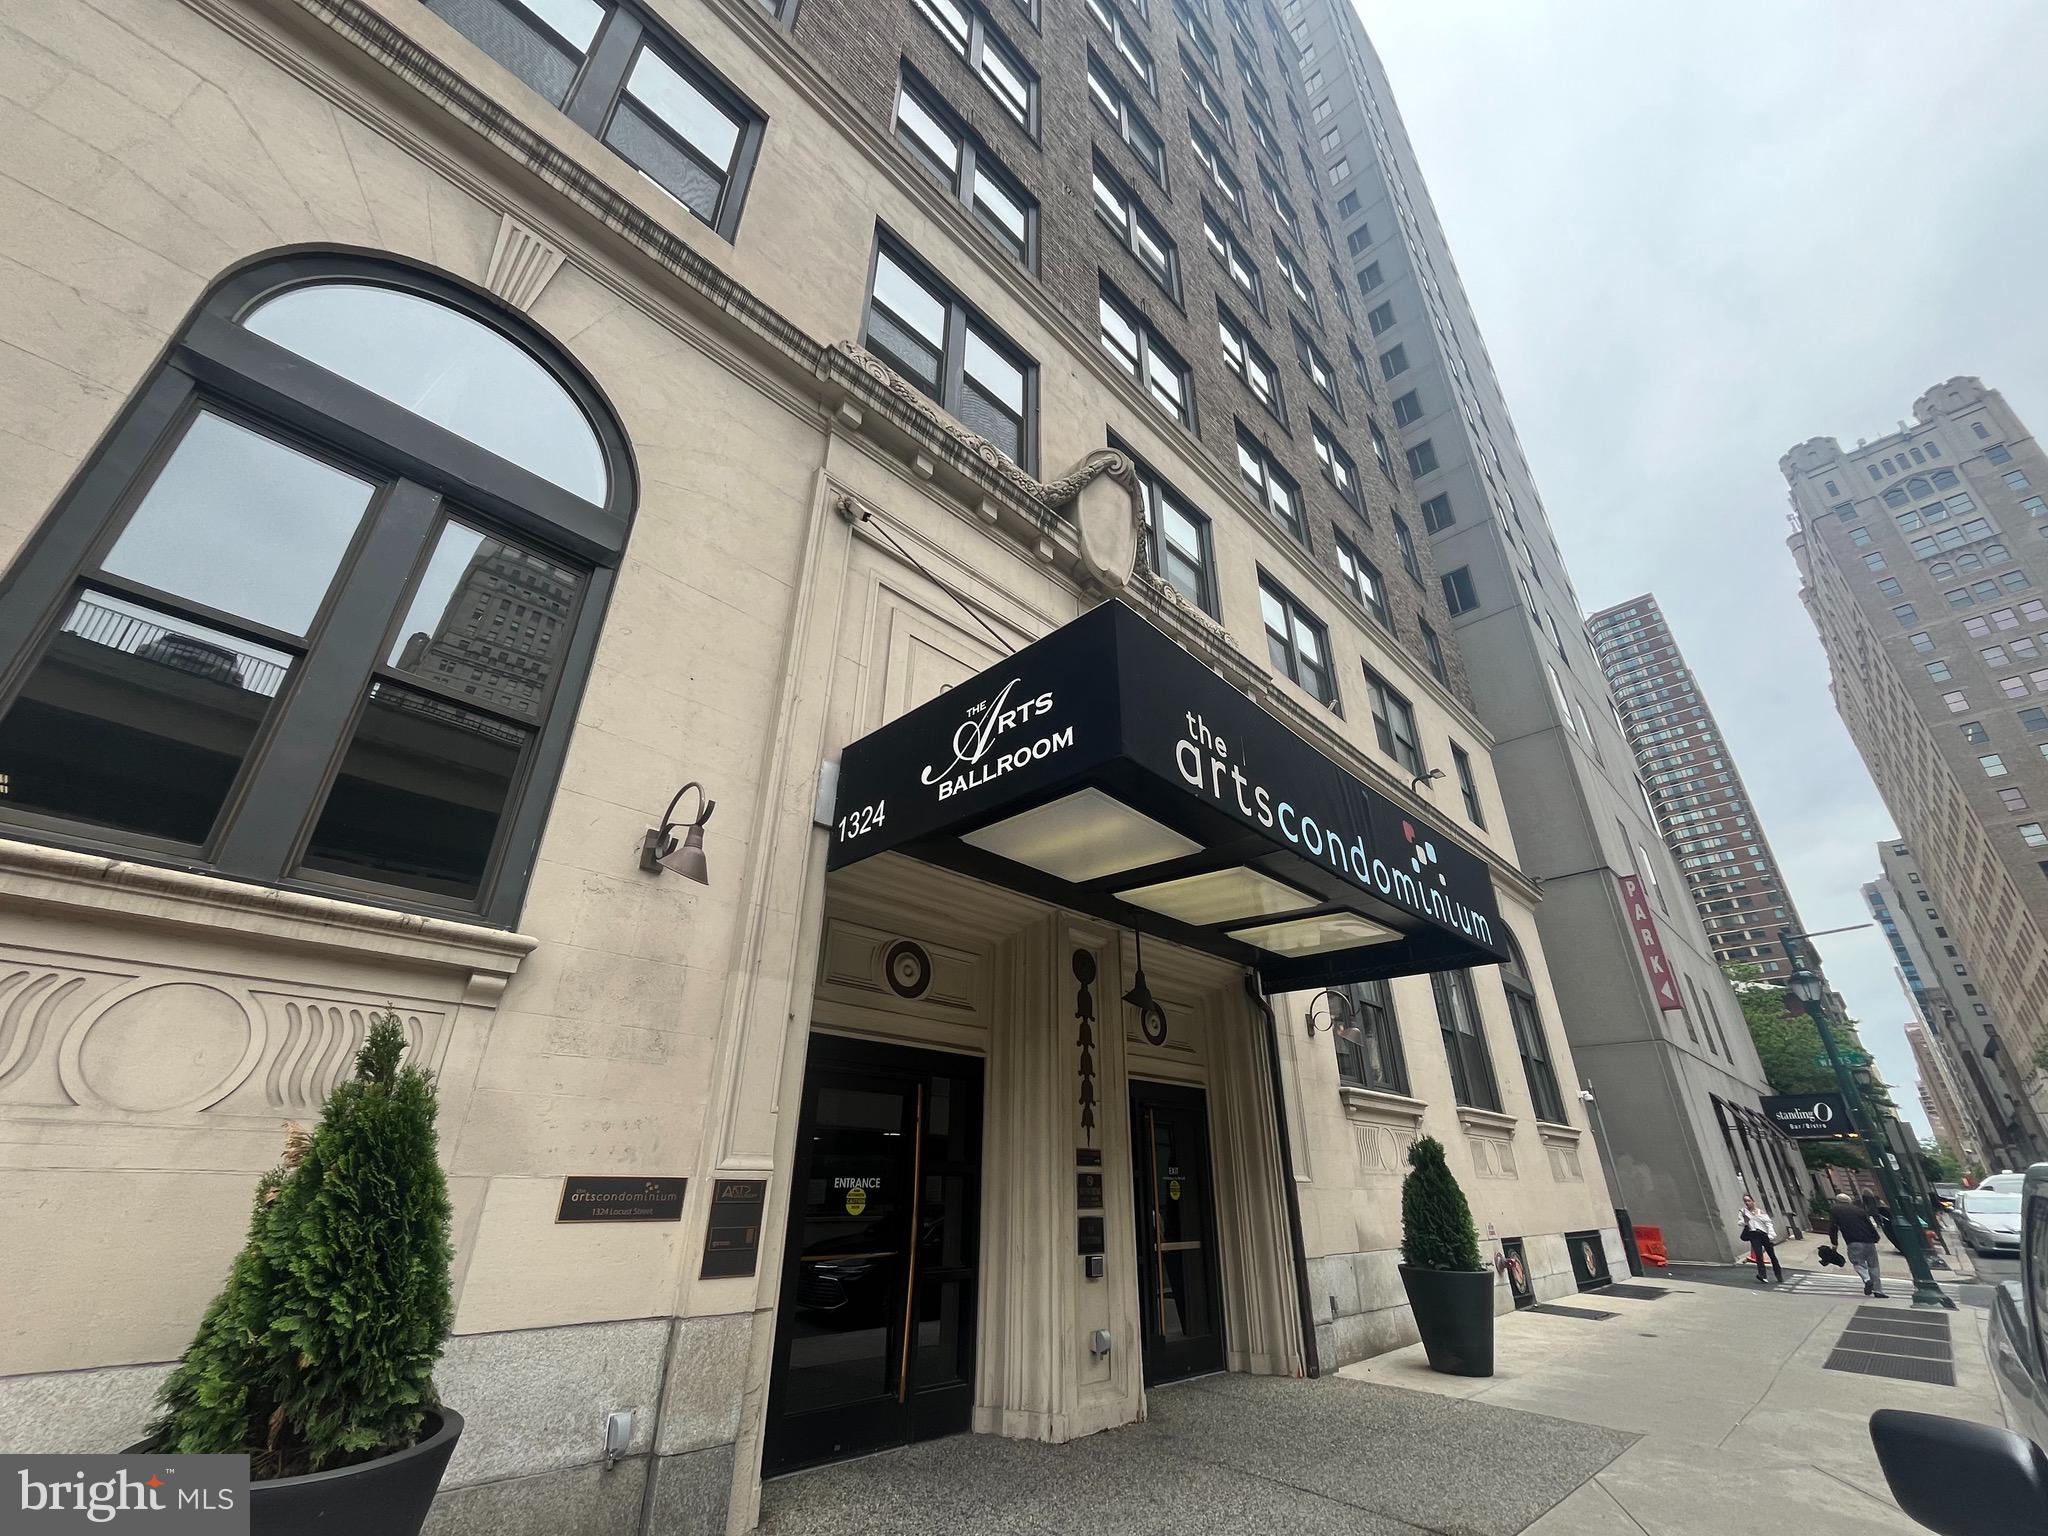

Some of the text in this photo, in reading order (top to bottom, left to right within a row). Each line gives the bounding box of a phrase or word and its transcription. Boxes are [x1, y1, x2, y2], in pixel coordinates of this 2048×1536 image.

[966, 700, 987, 718] THE
[1185, 710, 1227, 758] the
[938, 726, 1074, 801] BALLROOM
[838, 799, 886, 842] 1324
[1625, 880, 1665, 974] PARK
[834, 1177, 881, 1189] ENTRANCE
[592, 1208, 609, 1216] 1324
